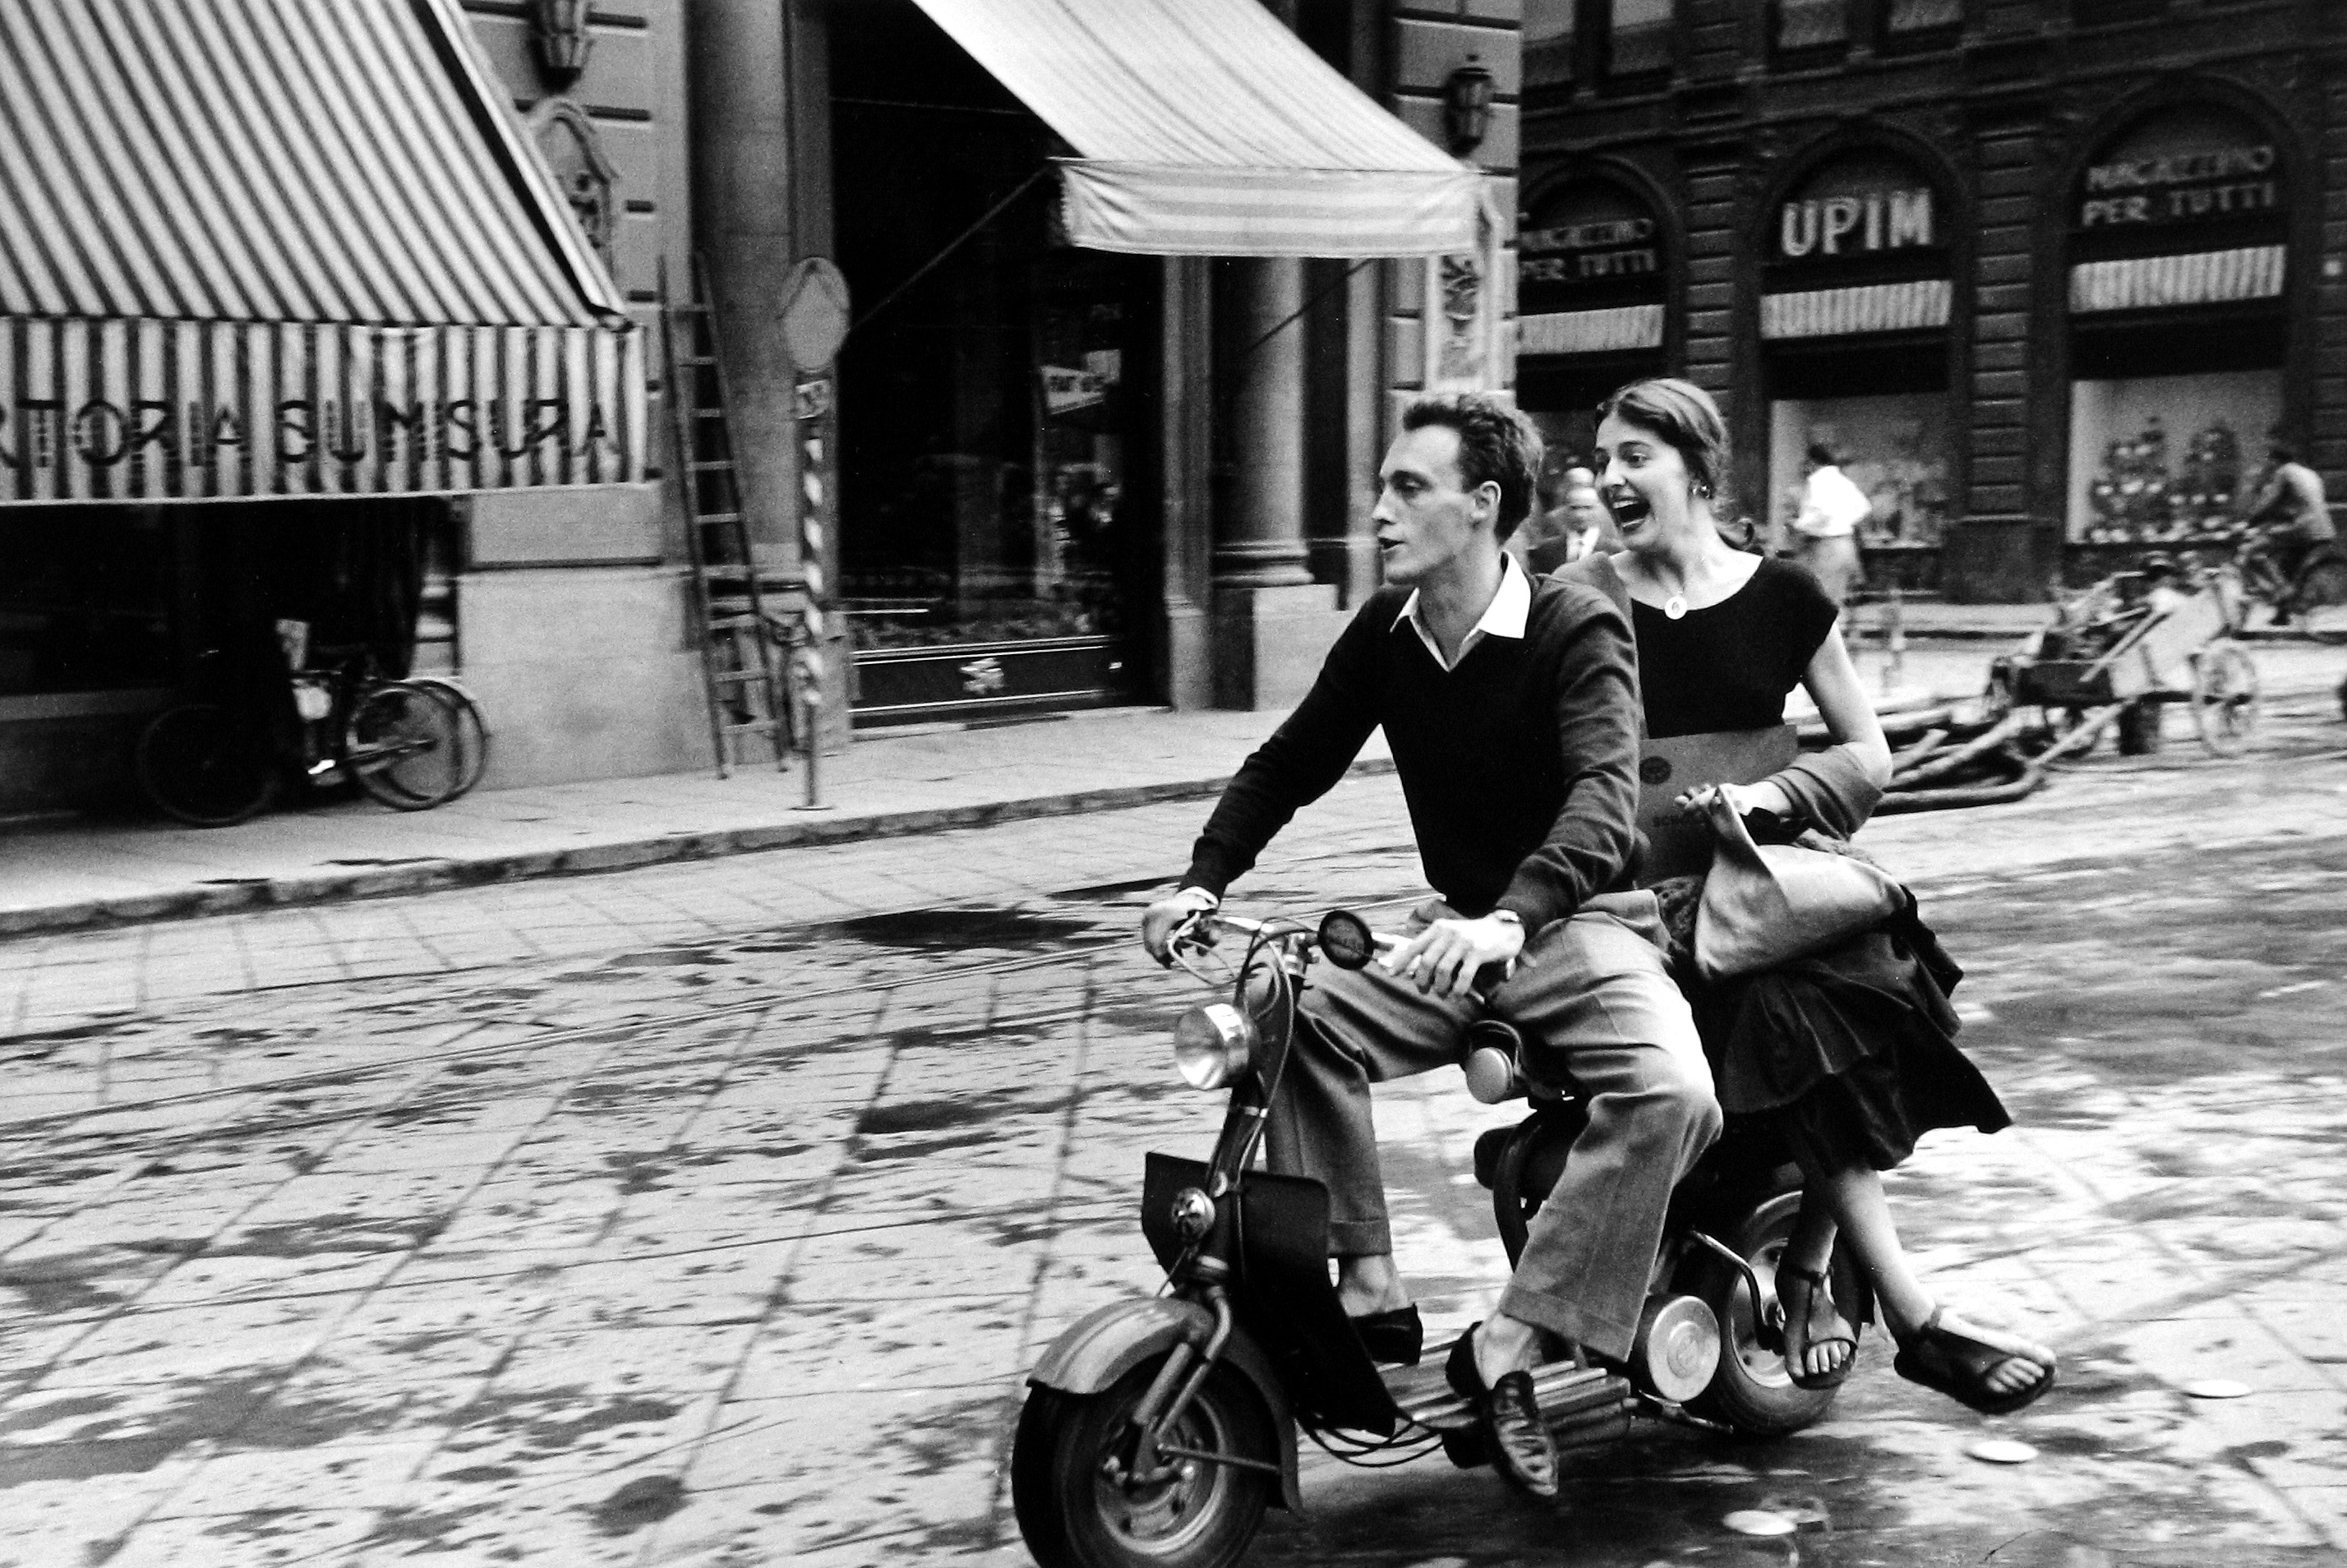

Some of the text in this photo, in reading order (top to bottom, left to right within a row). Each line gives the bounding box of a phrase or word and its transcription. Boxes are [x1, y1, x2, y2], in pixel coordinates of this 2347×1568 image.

[1782, 187, 1931, 256] UPIM
[2082, 182, 2274, 226] PER TUTTI
